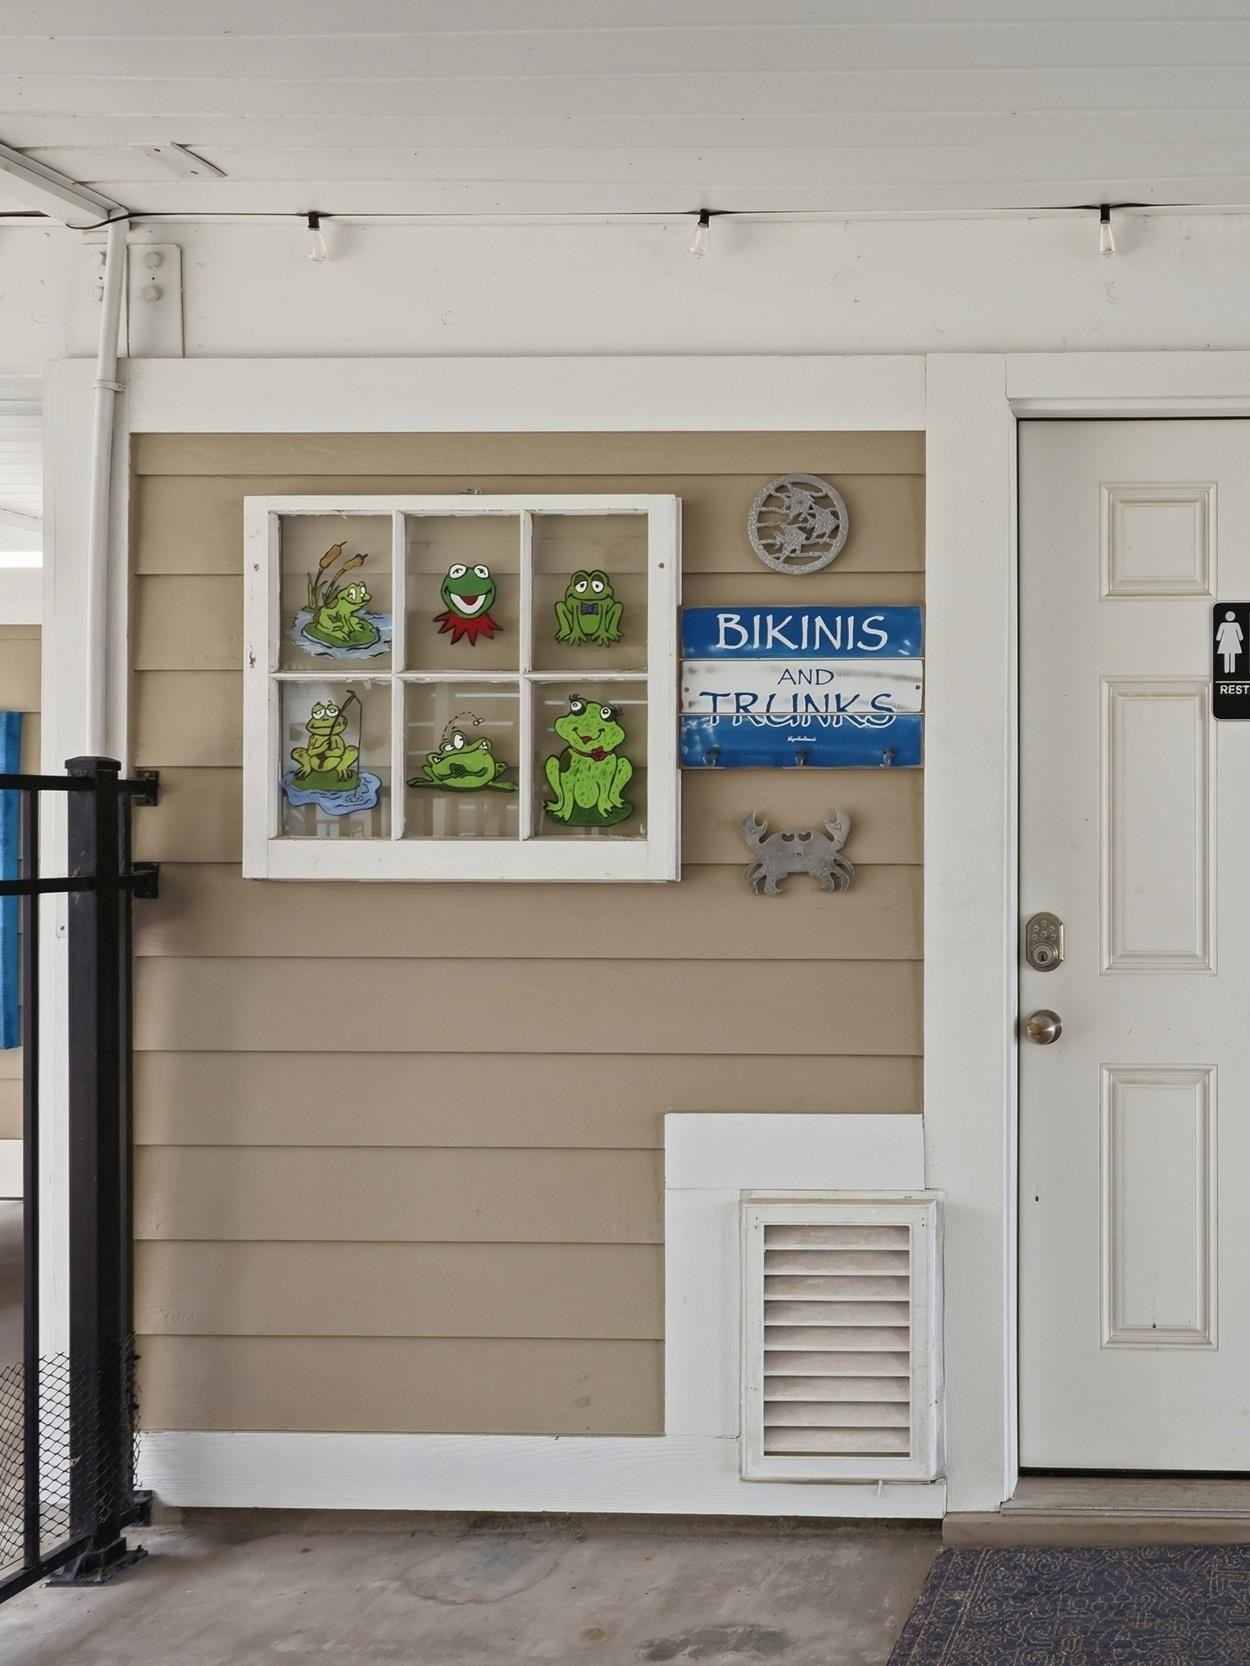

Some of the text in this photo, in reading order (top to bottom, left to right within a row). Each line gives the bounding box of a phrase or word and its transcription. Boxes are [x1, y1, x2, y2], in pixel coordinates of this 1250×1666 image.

[716, 613, 888, 651] BIKINIS
[777, 668, 834, 685] AND
[699, 691, 896, 729] TRUNKS
